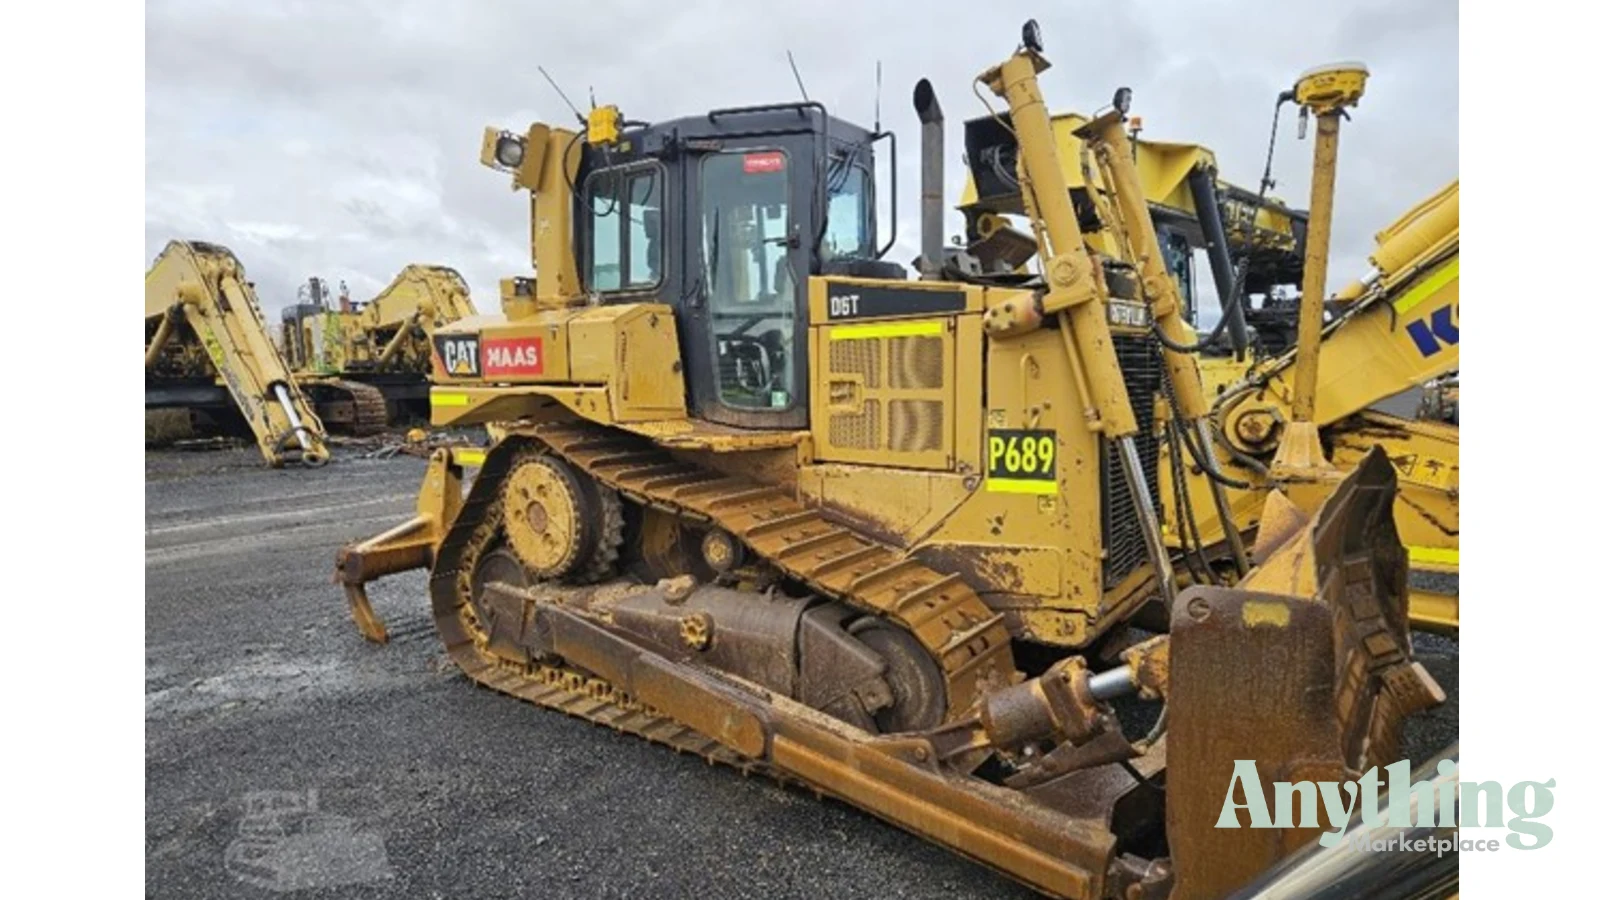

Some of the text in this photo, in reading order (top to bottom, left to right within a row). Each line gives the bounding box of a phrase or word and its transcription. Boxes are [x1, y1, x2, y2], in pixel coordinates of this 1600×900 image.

[831, 295, 860, 316] D6T
[1405, 303, 1459, 358] K
[444, 340, 478, 374] CAT
[487, 346, 538, 367] MAAS
[989, 436, 1054, 473] P689
